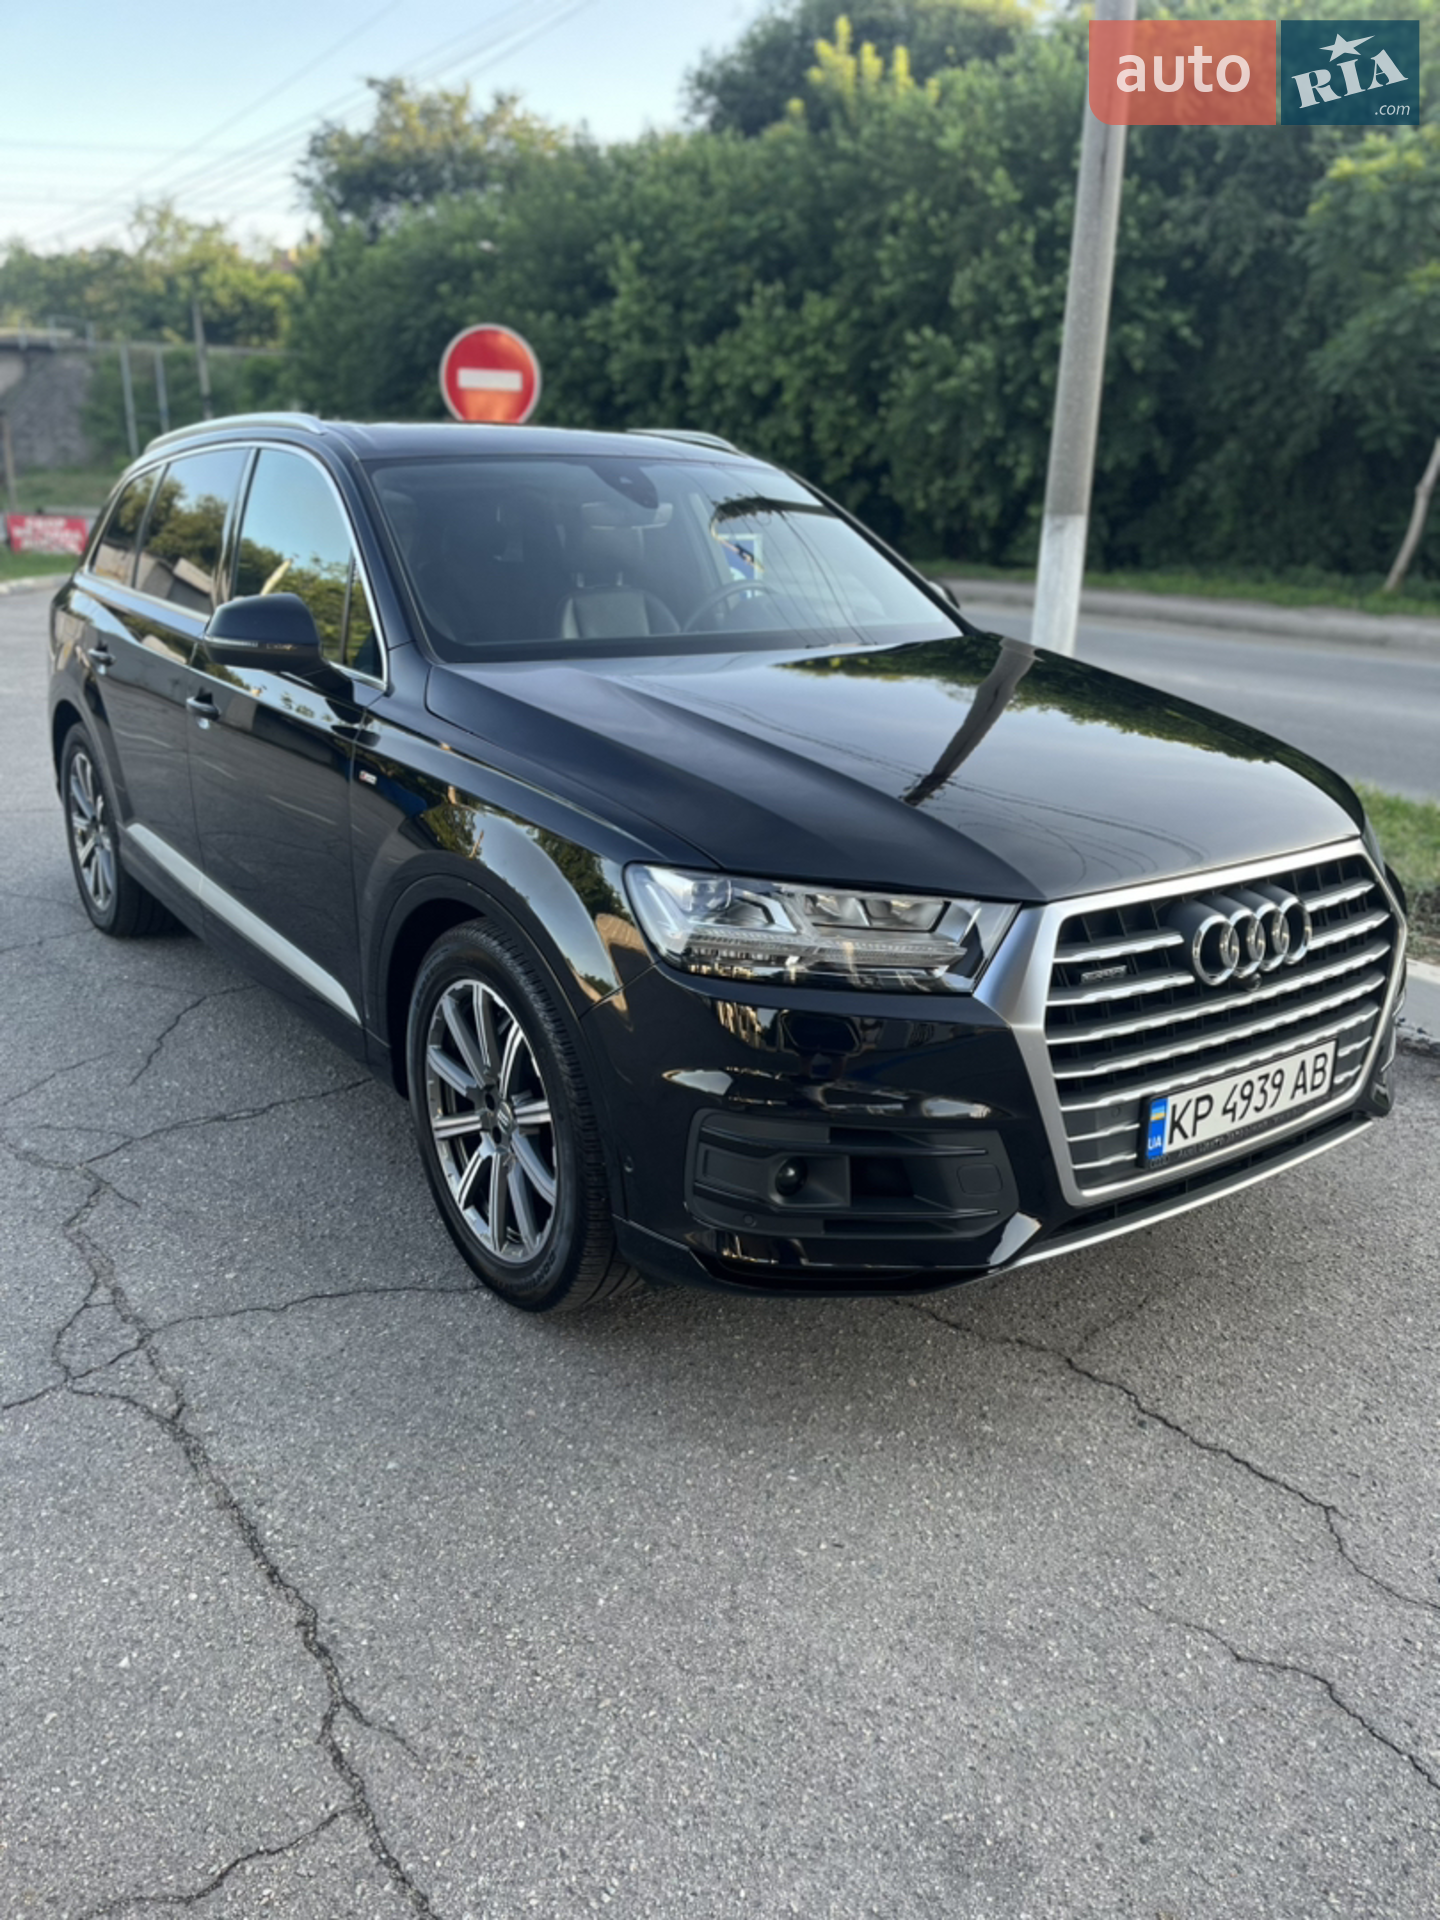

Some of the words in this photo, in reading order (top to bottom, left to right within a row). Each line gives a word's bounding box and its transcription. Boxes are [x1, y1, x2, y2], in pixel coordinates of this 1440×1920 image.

[1167, 1093, 1214, 1145] KP
[1221, 1068, 1285, 1123] 4939
[1290, 1052, 1328, 1100] AB
[1147, 1136, 1162, 1150] UA
